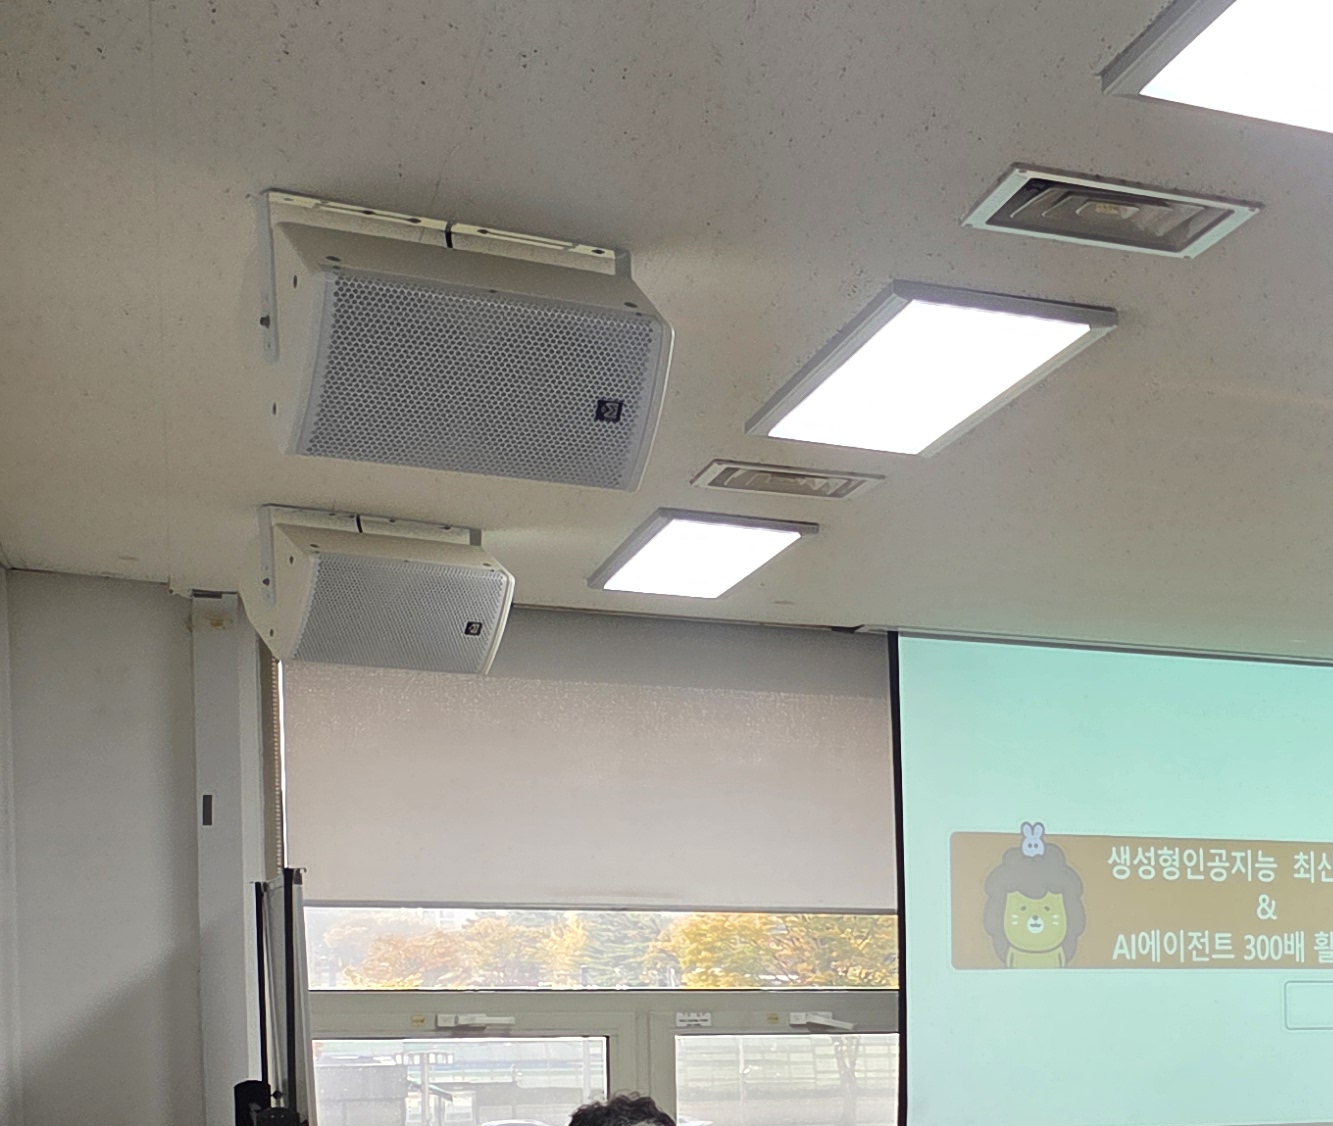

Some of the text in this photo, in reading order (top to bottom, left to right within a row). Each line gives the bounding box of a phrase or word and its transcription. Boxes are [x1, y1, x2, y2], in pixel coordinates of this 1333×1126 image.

[1107, 845, 1278, 882] 생성형인공지능
[1256, 895, 1277, 921] &
[1112, 929, 1236, 964] AI에이전트
[1244, 930, 1305, 963] 300배
